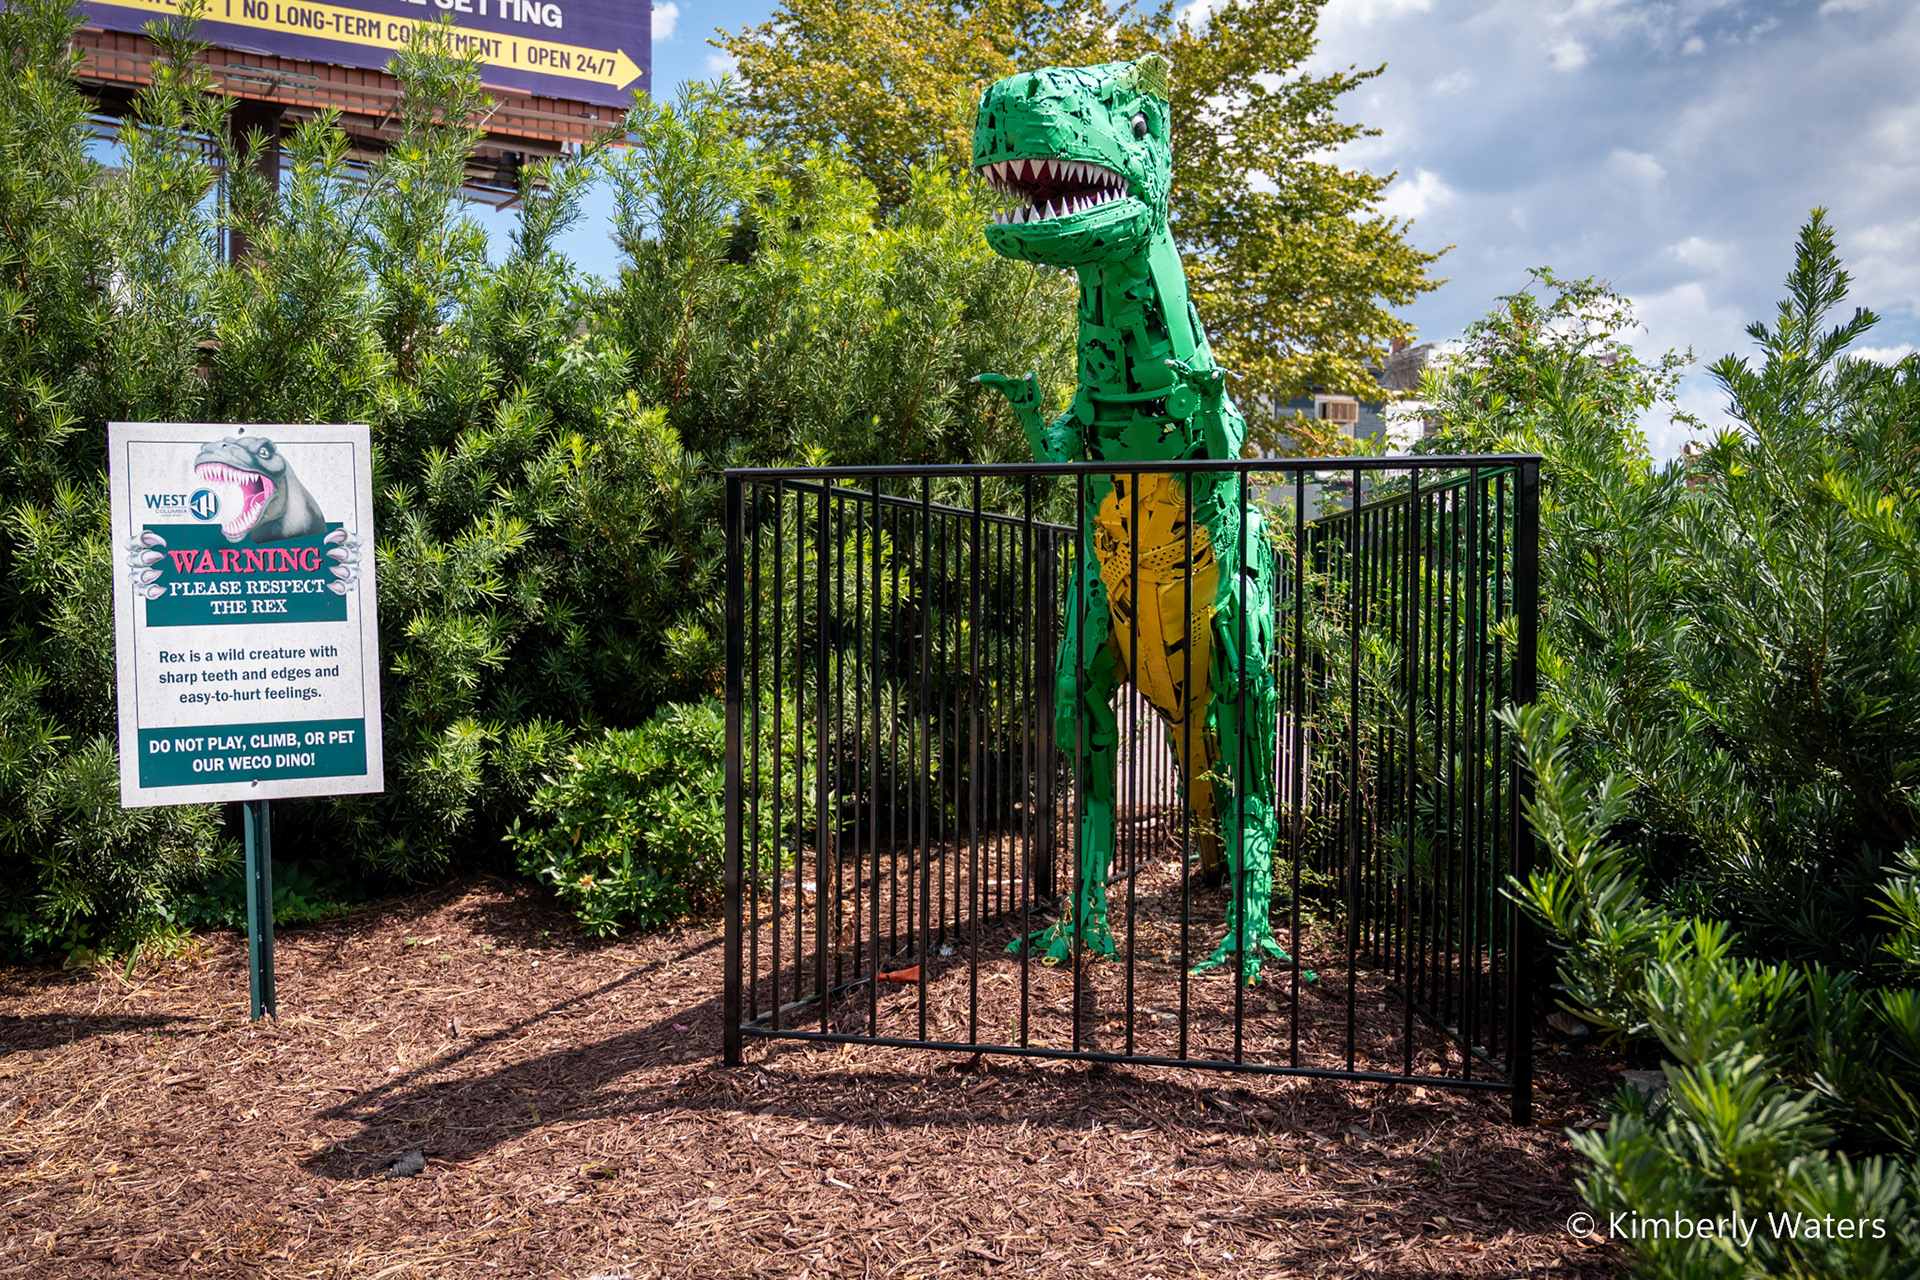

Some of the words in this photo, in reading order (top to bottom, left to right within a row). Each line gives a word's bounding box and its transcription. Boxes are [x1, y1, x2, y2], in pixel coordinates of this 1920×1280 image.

[243, 1, 268, 20] NO
[276, 4, 381, 39] LONG-TERM
[388, 23, 502, 58] COTMENT
[527, 46, 571, 70] OPEN
[576, 54, 615, 77] 24/7
[144, 494, 187, 509] WEST
[168, 547, 323, 575] WARNING
[170, 580, 242, 597] PLEASE
[245, 579, 325, 595] RESPECT
[210, 600, 247, 615] THE
[251, 599, 288, 614] REX
[159, 650, 185, 663] Rex
[190, 650, 201, 663] is
[205, 652, 213, 662] a
[217, 648, 245, 662] wild
[249, 648, 306, 661] creature
[310, 645, 338, 658] with
[159, 670, 198, 686] sharp
[201, 668, 238, 682] teeth
[242, 667, 267, 680] and
[271, 666, 311, 682] edges
[315, 664, 339, 678] and
[179, 687, 261, 705] easy-to-hurt
[265, 686, 322, 702] feelings.
[149, 739, 171, 754] DO
[175, 737, 204, 752] NOT
[207, 735, 246, 752] PLAY,
[250, 733, 301, 749] CLIMB,
[304, 731, 325, 745] OR
[328, 729, 355, 744] PET
[192, 757, 224, 772] OUR
[228, 755, 272, 770] WECO
[275, 752, 316, 768] DINO!
